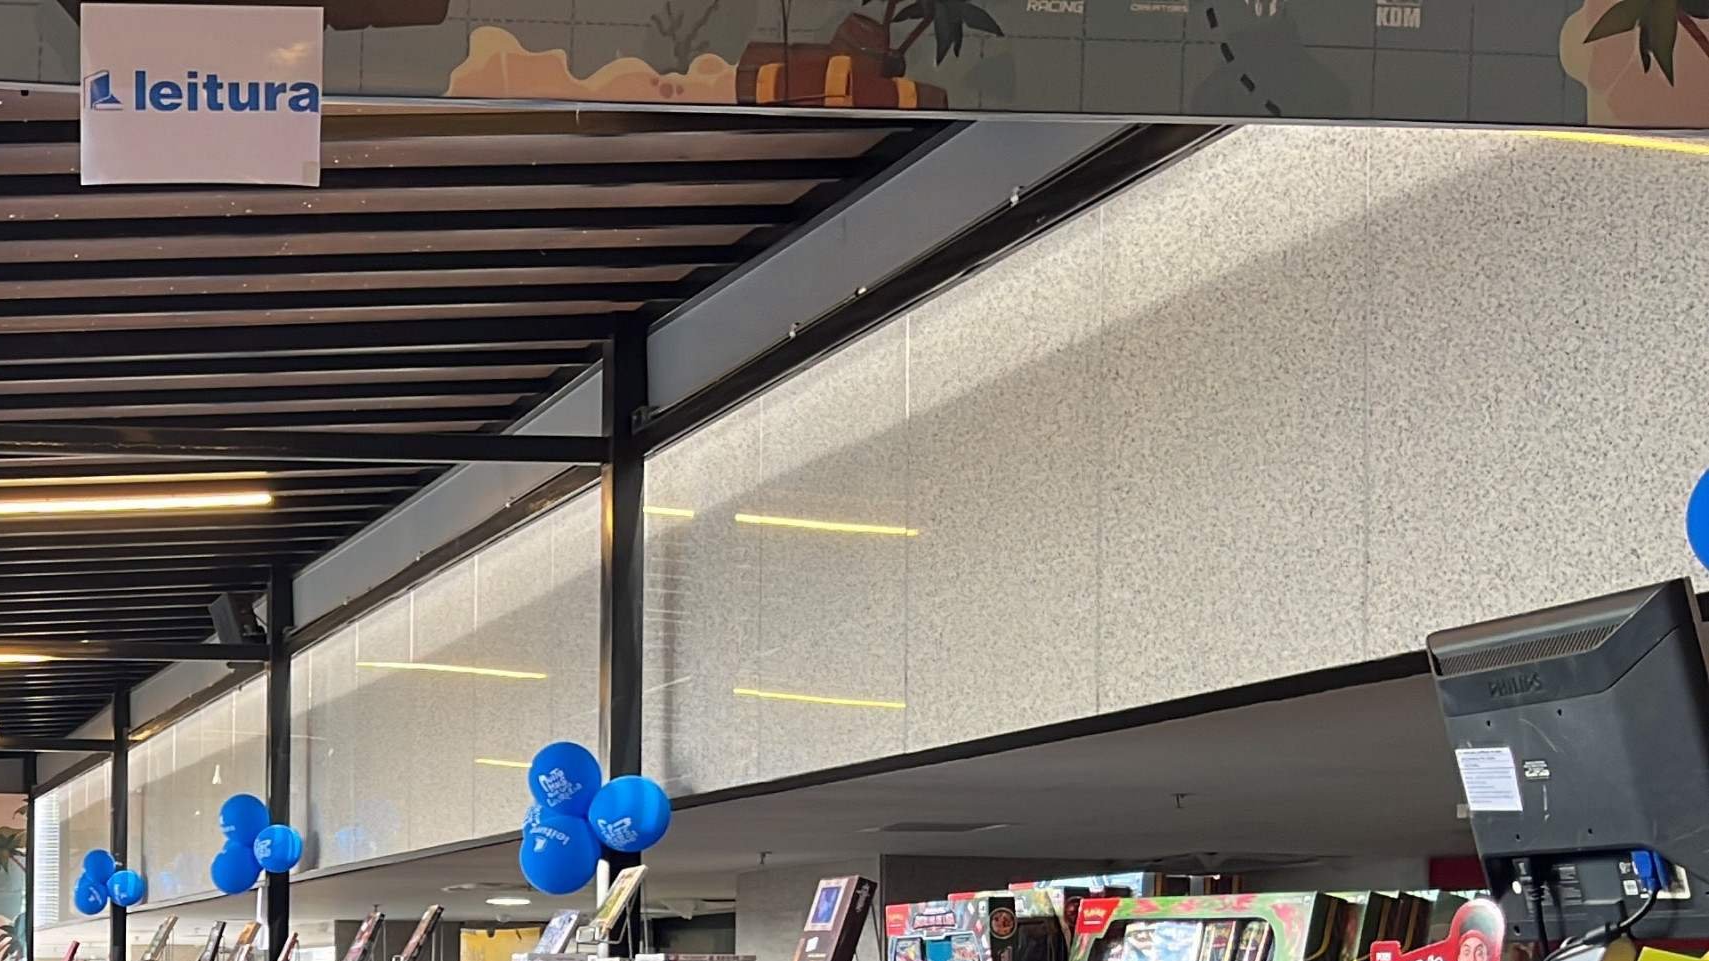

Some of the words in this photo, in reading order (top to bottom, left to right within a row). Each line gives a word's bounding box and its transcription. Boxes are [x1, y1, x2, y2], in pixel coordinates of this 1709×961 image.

[1026, 0, 1084, 14] RACING
[135, 70, 319, 112] leitura
[1488, 672, 1541, 697] PHILIPS
